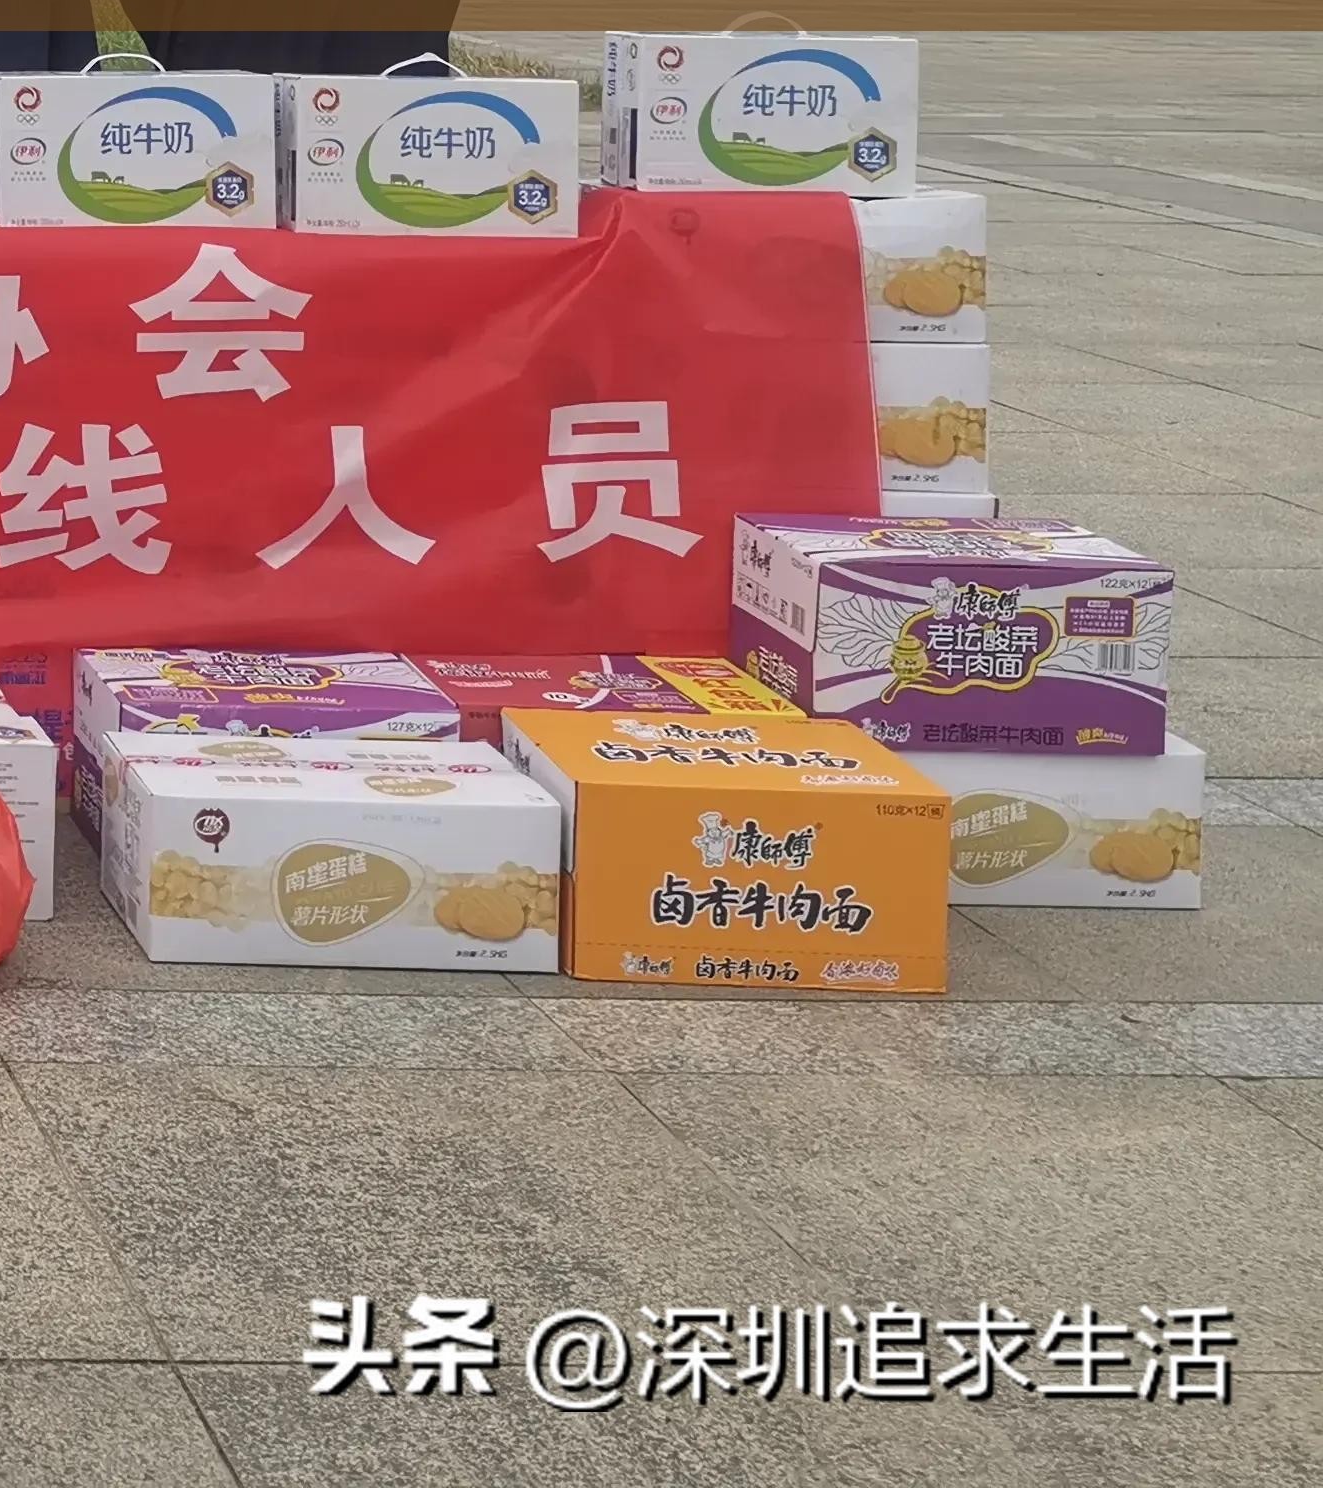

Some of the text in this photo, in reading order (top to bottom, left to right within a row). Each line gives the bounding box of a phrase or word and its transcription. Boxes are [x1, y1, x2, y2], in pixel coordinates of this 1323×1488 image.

[742, 83, 837, 117] 纯牛奶
[15, 144, 41, 158] 伊利
[100, 122, 193, 155] 纯牛奶
[400, 125, 495, 160] 纯牛奶
[312, 146, 339, 159] 伊利
[857, 147, 887, 165] 3.2g
[216, 182, 245, 200] 3.2g
[519, 190, 547, 208] 3.2g
[926, 623, 1039, 654] 老坛酸菜
[935, 653, 1023, 678] 牛肉面
[922, 723, 1064, 746] 老坛酸菜牛肉面
[592, 742, 860, 769] 卤香牛肉面
[732, 820, 814, 869] 康師傅
[653, 874, 873, 934] 卤香牛肉面
[696, 954, 800, 982] 卤香牛肉面
